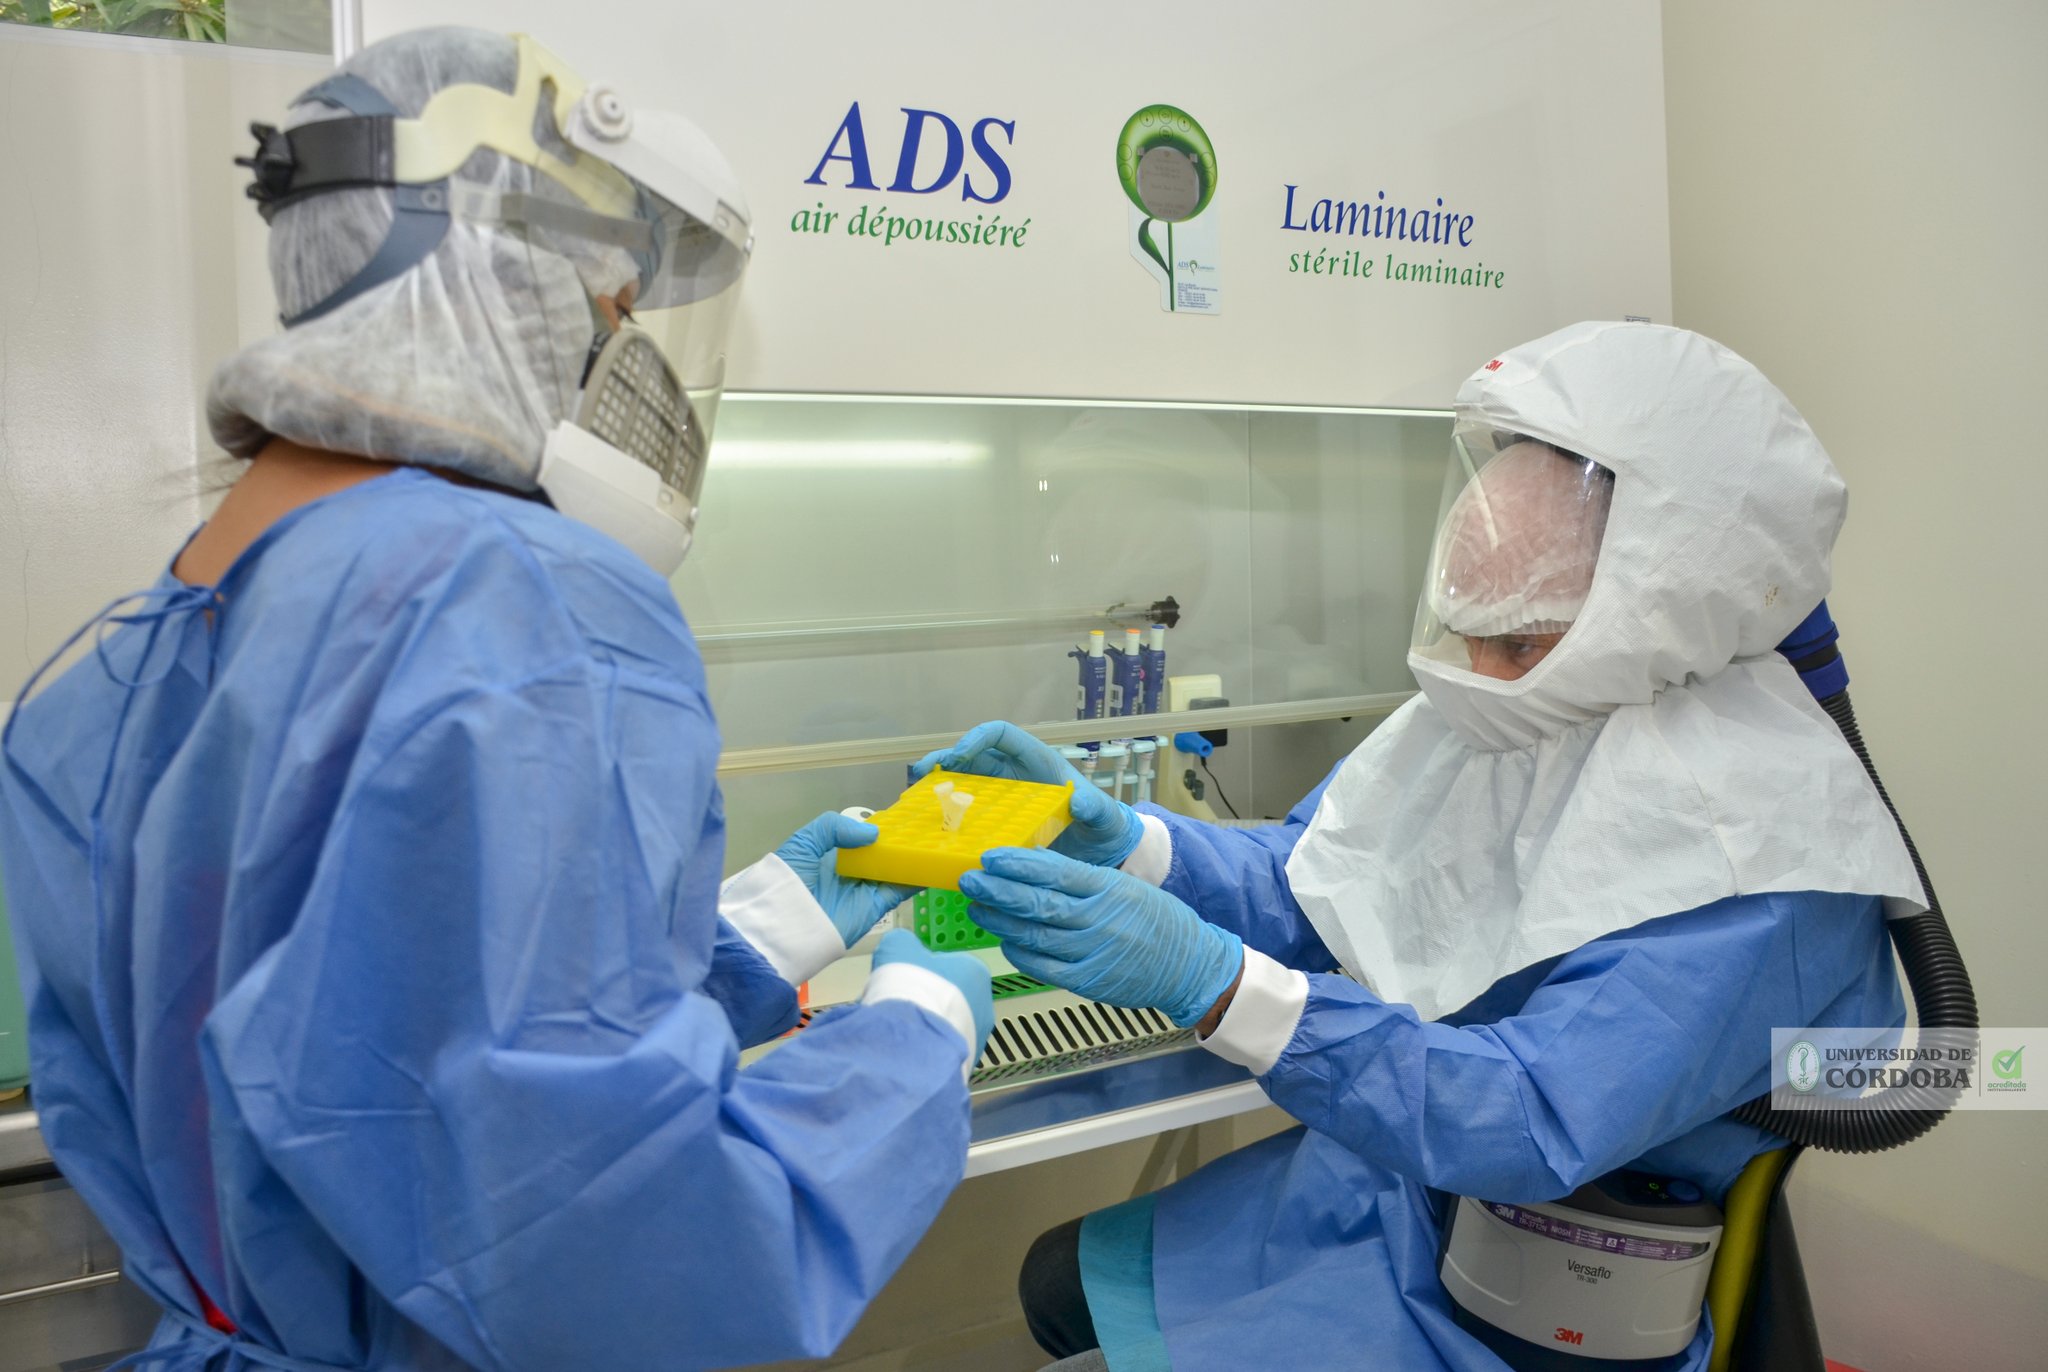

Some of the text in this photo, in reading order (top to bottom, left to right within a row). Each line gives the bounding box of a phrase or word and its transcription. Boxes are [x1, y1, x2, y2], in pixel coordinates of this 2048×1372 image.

[803, 101, 1016, 205] ADS
[790, 202, 1032, 248] air dépoussiéré
[1280, 184, 1474, 248] Laminaire
[1289, 247, 1505, 289] stérile laminaire
[1485, 359, 1504, 372] 3M
[1495, 1204, 1515, 1220] 3M
[1567, 1259, 1612, 1280] Versaflo
[1554, 1327, 1584, 1346] 3M
